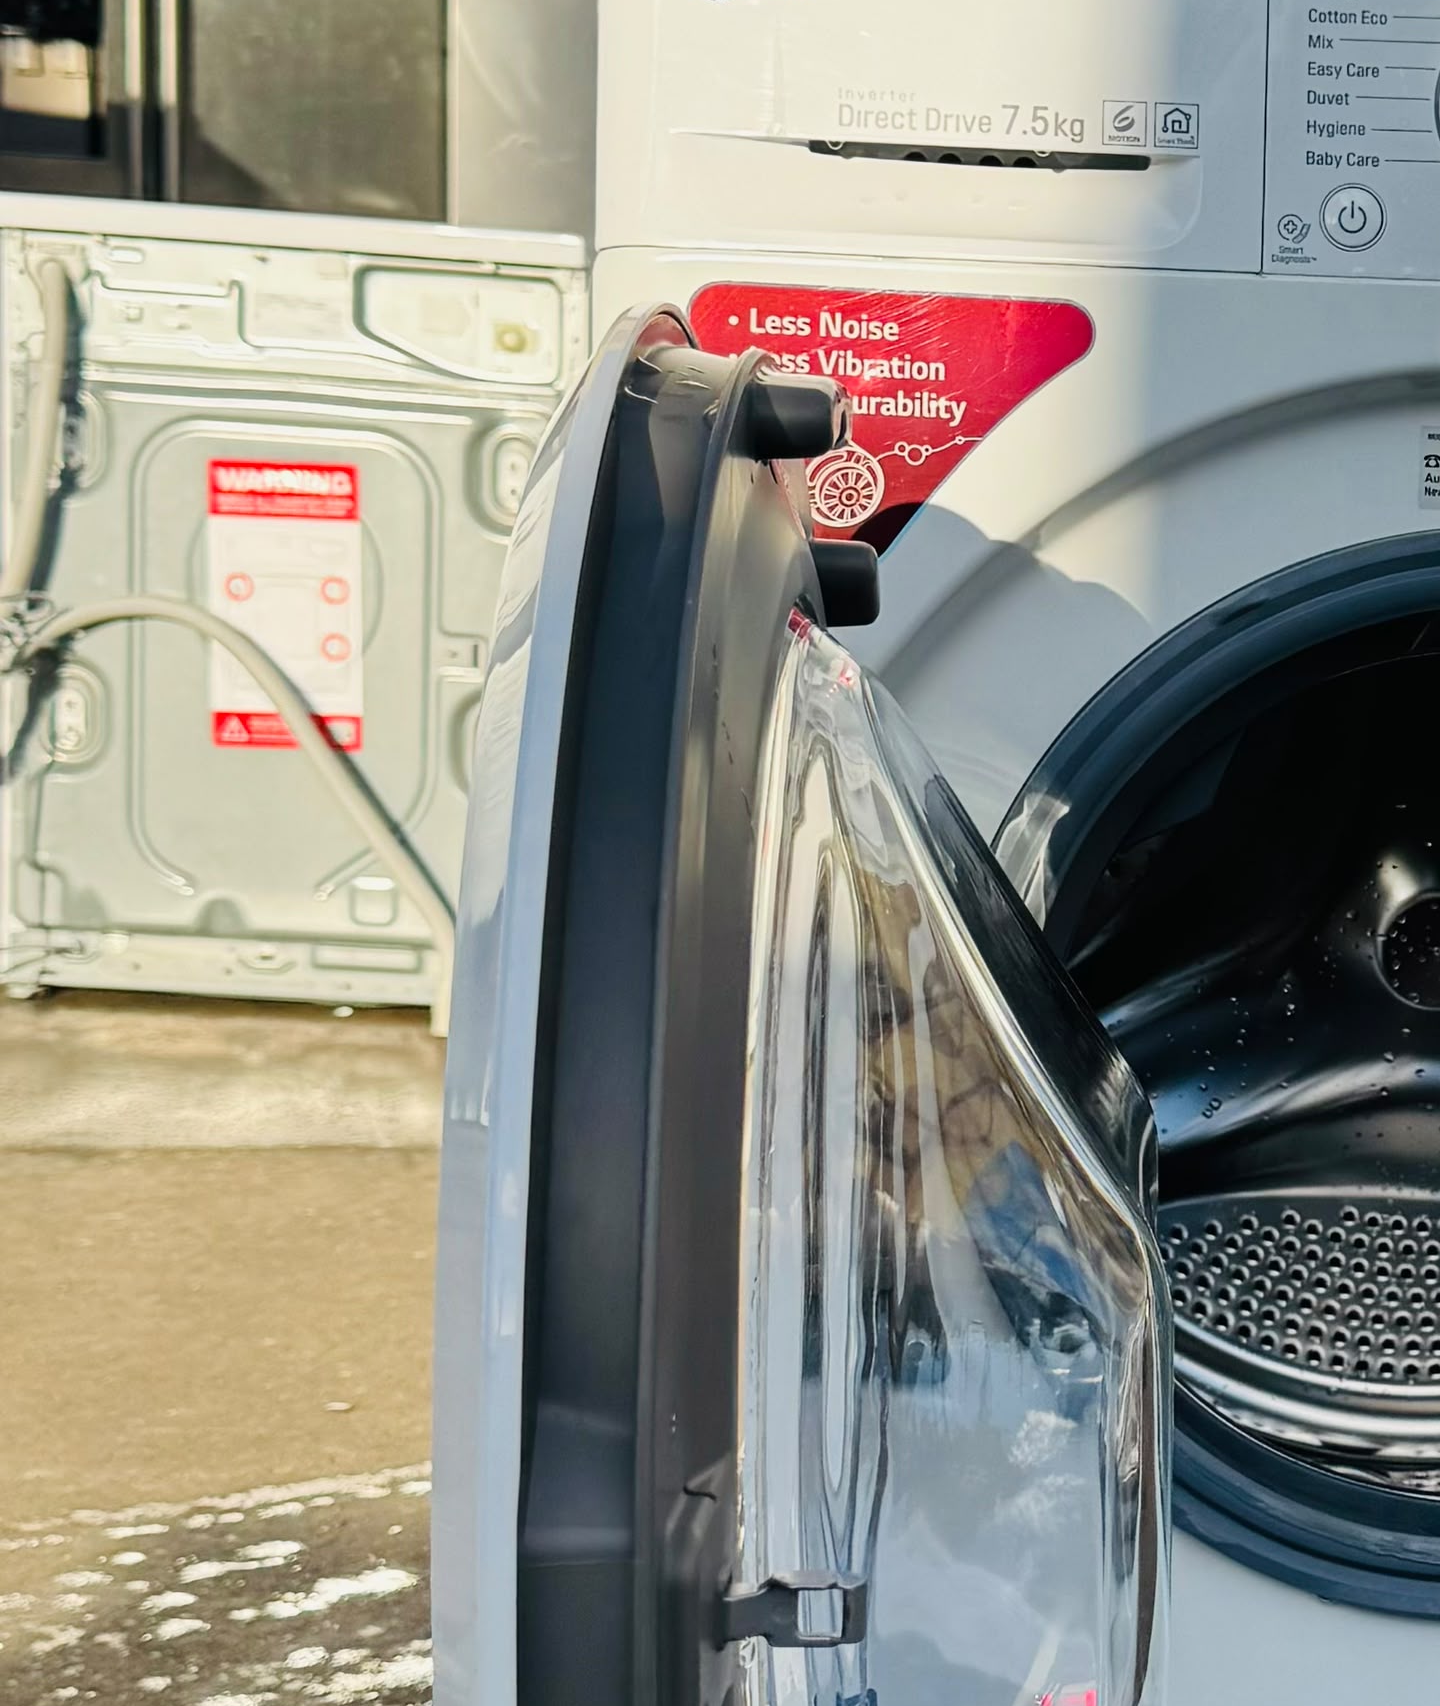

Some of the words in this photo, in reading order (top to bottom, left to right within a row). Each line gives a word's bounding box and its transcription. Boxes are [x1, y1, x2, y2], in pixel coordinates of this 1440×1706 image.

[1308, 8, 1358, 24] Cotton
[1361, 10, 1388, 25] Eco
[1308, 34, 1334, 49] Mix
[1307, 61, 1343, 80] Easy
[1346, 62, 1380, 78] Care
[837, 86, 917, 103] Inverter
[1306, 90, 1350, 106] Duvet
[838, 103, 918, 132] Direct
[925, 107, 992, 134] Drive
[1306, 119, 1366, 138] Hygiene
[1305, 150, 1343, 169] Baby
[1346, 152, 1380, 168] Care
[749, 307, 812, 338] Less
[818, 310, 900, 341] Noise
[817, 349, 946, 382] Vibration
[850, 390, 967, 427] urability
